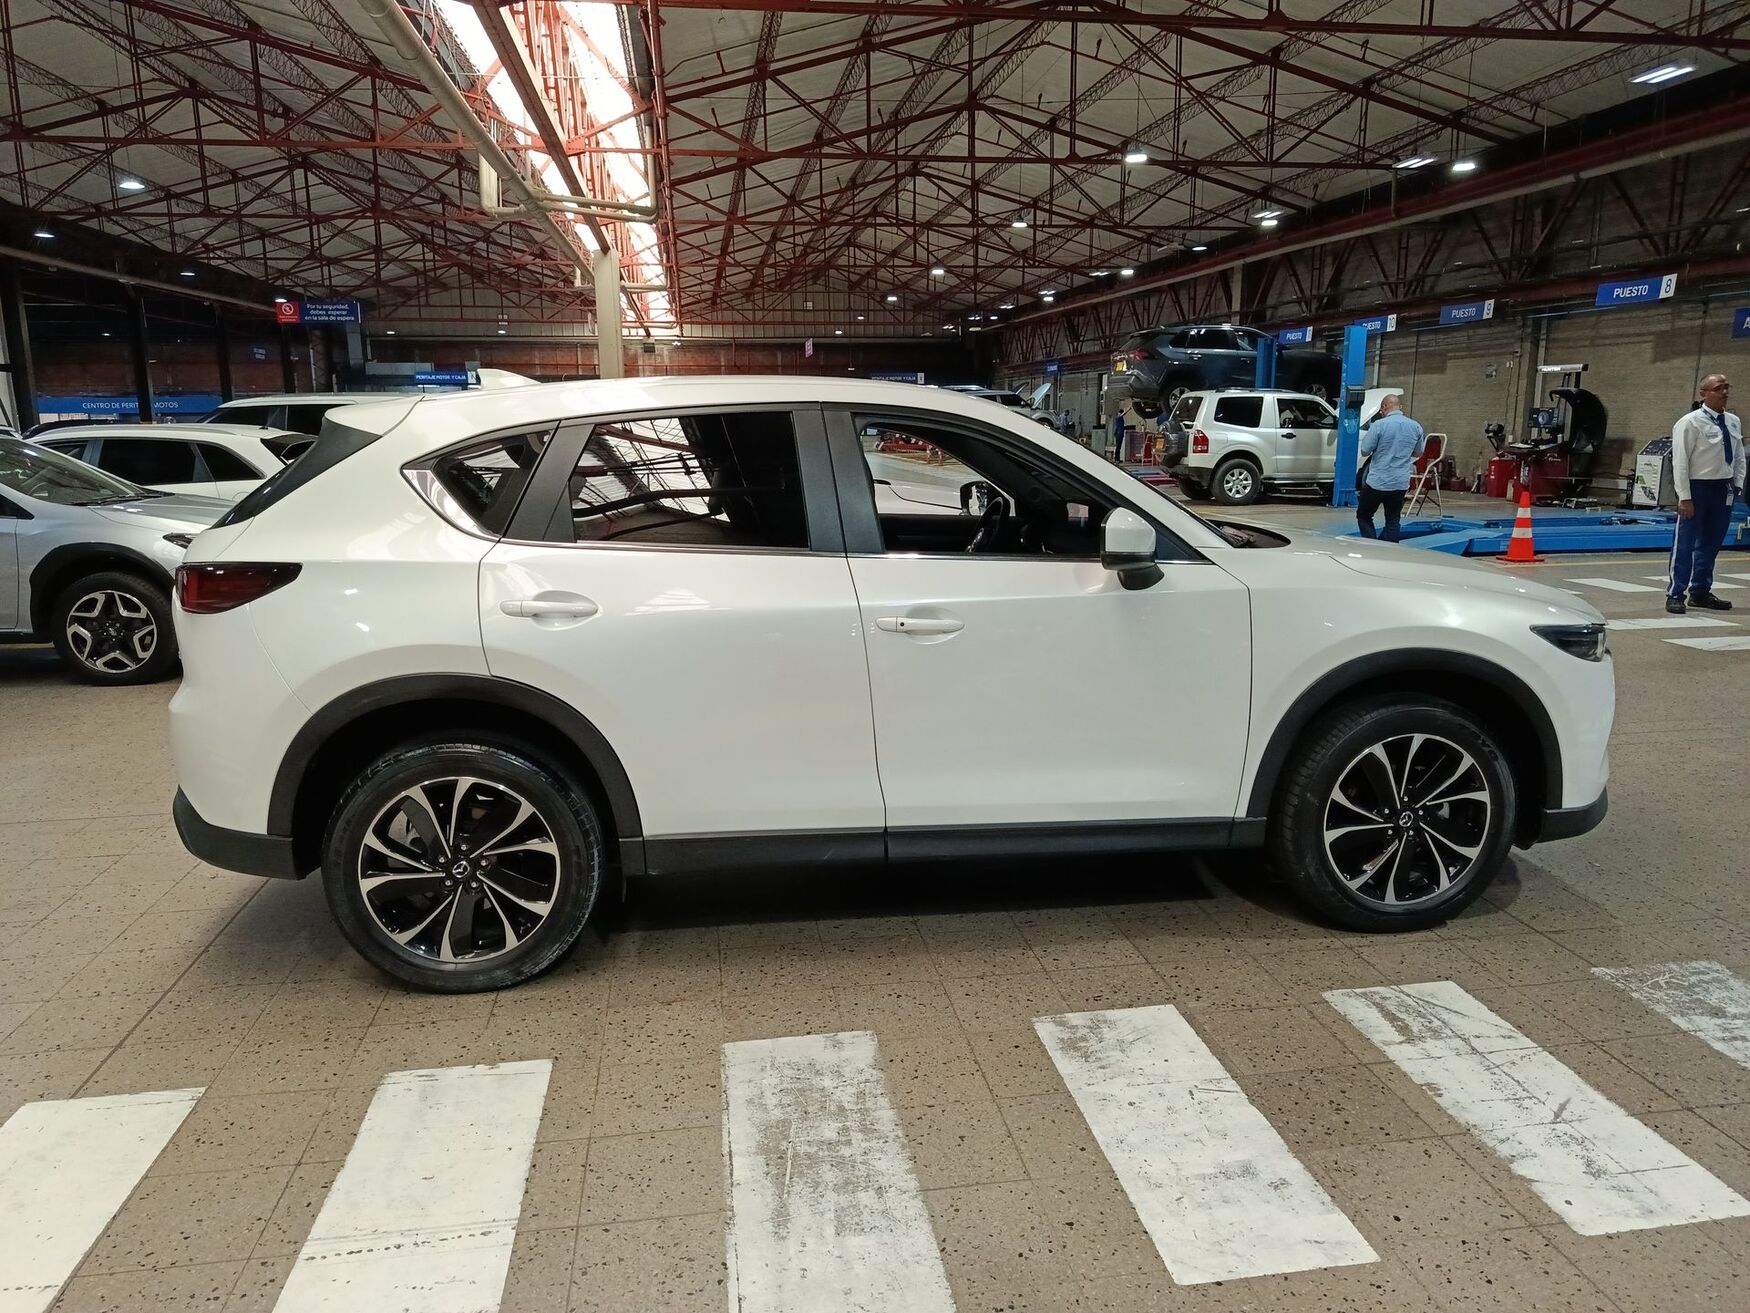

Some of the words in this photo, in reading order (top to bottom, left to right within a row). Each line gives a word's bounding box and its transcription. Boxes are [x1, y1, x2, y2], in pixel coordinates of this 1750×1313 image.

[1613, 285, 1649, 298] PUESTO
[1664, 278, 1672, 294] 8
[1452, 308, 1476, 318] PUESTO
[1486, 302, 1492, 316] 9
[1388, 317, 1395, 329] 10
